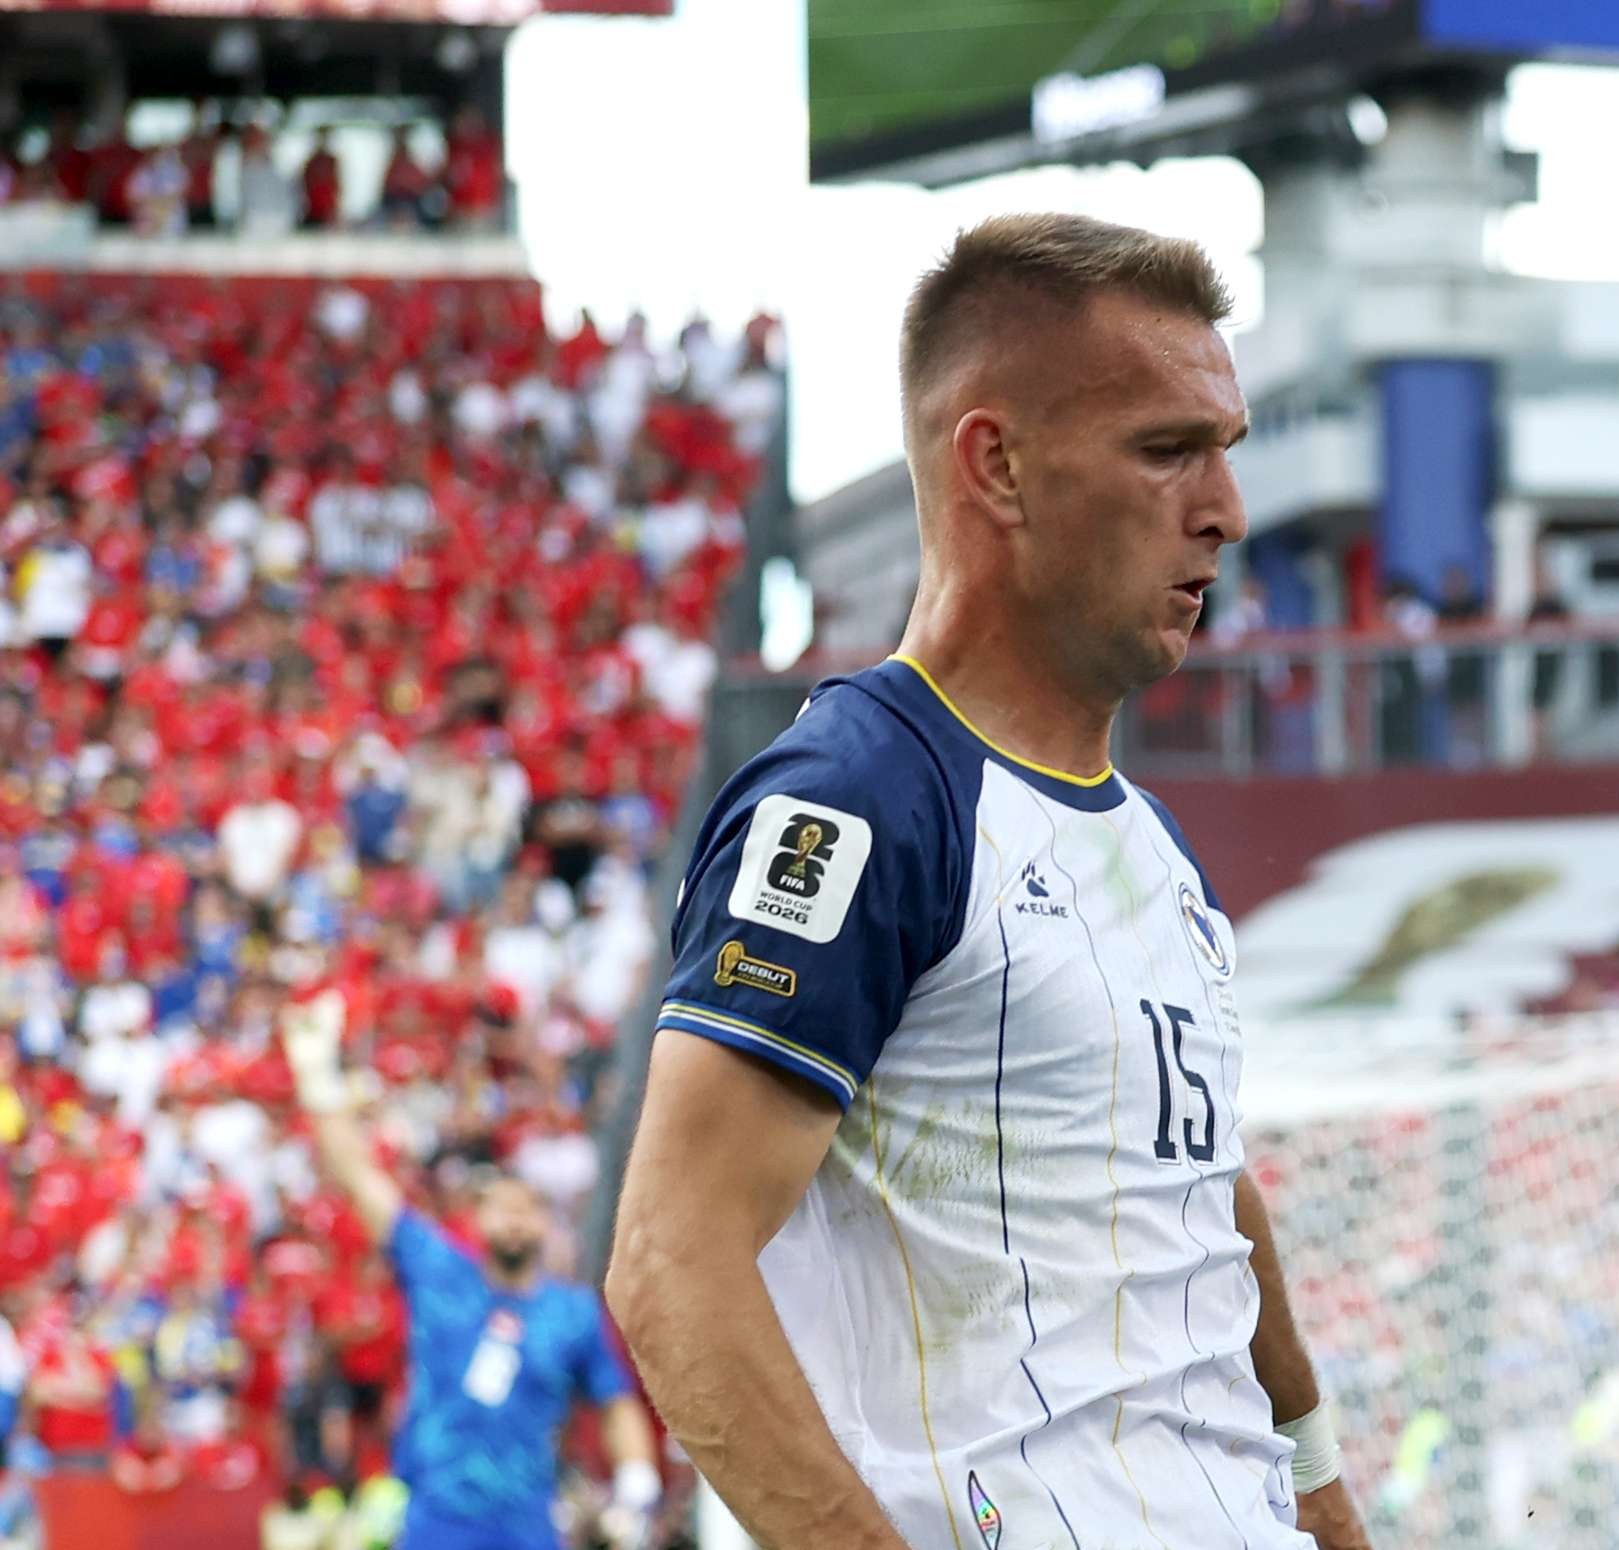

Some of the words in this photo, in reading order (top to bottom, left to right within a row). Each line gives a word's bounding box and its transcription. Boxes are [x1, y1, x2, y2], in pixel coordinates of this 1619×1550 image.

[779, 874, 806, 891] FIFA
[754, 900, 809, 925] 2026
[760, 891, 793, 905] WORLD
[793, 900, 813, 912] CUP
[1016, 901, 1069, 919] KELME
[737, 961, 790, 984] DEBUT
[1140, 998, 1218, 1164] 15
